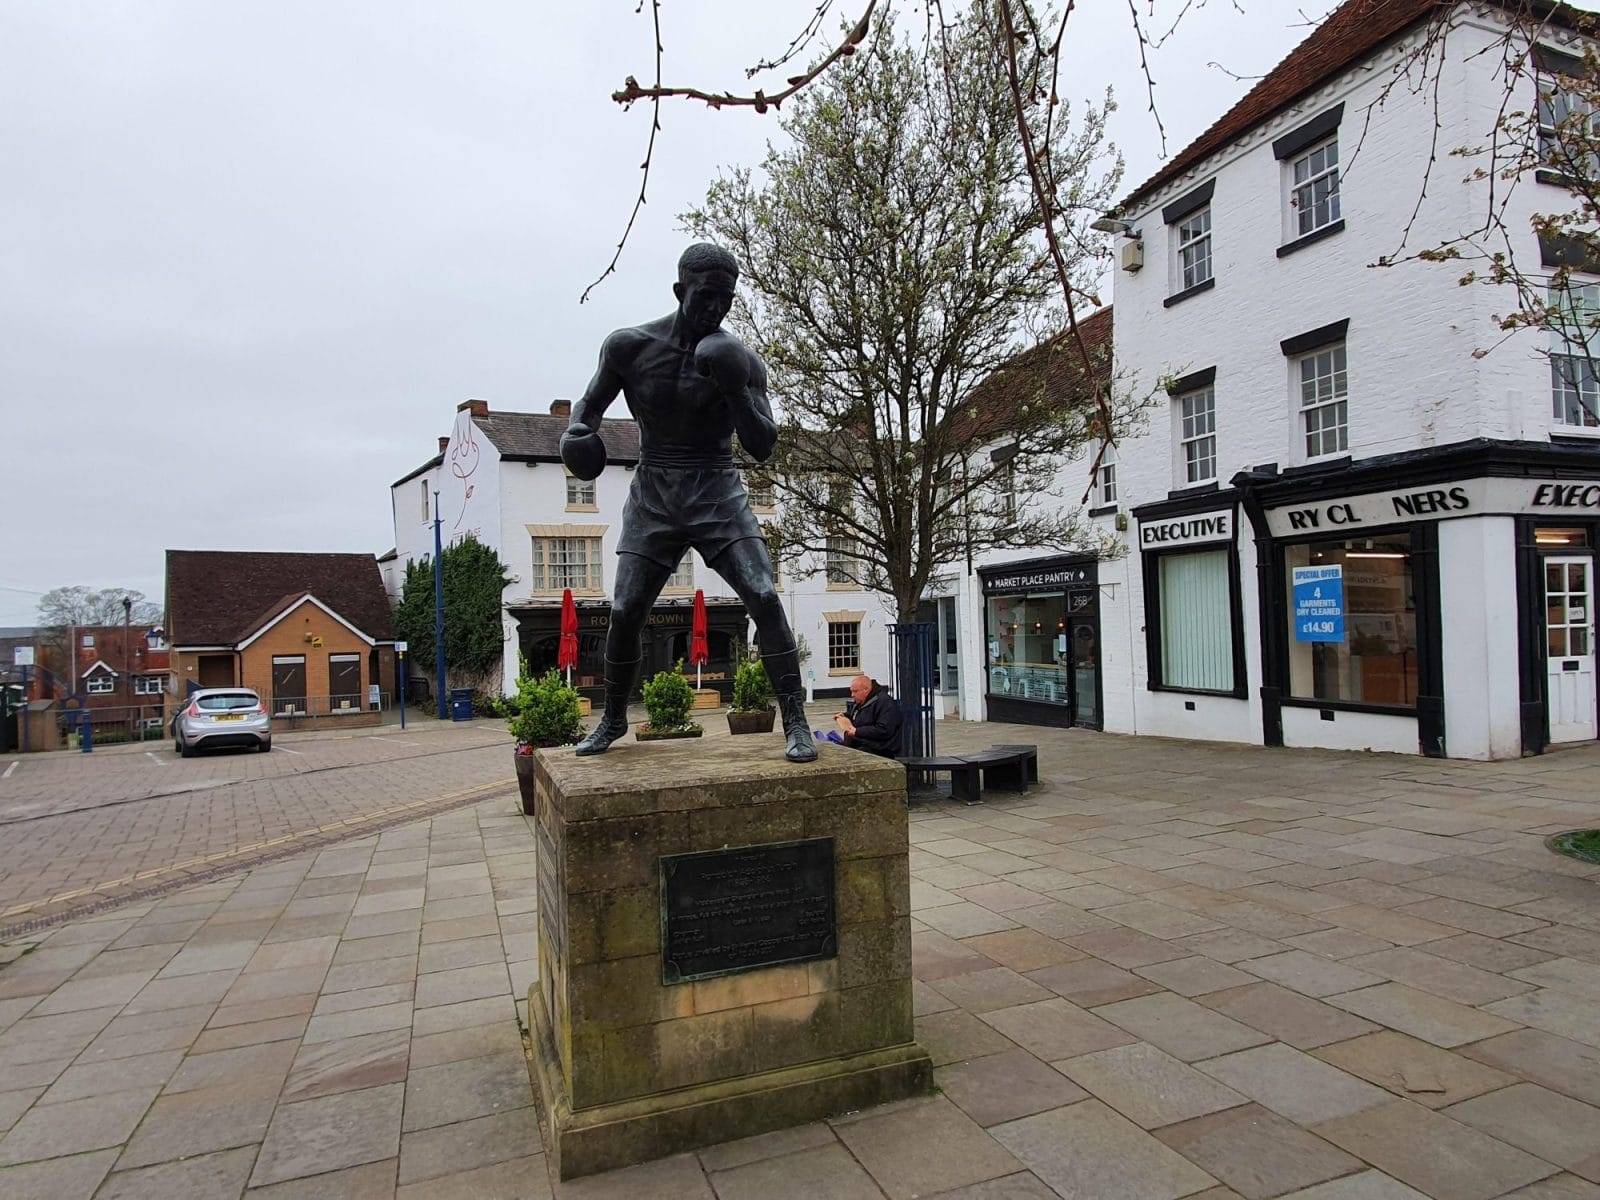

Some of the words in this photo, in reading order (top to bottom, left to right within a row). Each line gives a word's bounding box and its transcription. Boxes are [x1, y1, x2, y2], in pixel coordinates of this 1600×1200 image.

[1288, 508, 1323, 530] RY
[1391, 487, 1470, 517] NERS
[1143, 516, 1227, 543] EXECUTIVE
[994, 577, 1020, 588] MARKET
[1021, 574, 1044, 586] PLACE
[1044, 571, 1075, 583] PANTRY
[1296, 570, 1319, 579] SPECIAL
[1320, 569, 1339, 577] OFFER
[1314, 587, 1321, 598] 4
[1300, 600, 1336, 608] GARMENTS
[1297, 608, 1309, 616] DRY
[1311, 608, 1340, 616] CLEANED
[1303, 622, 1334, 633] £14.90
